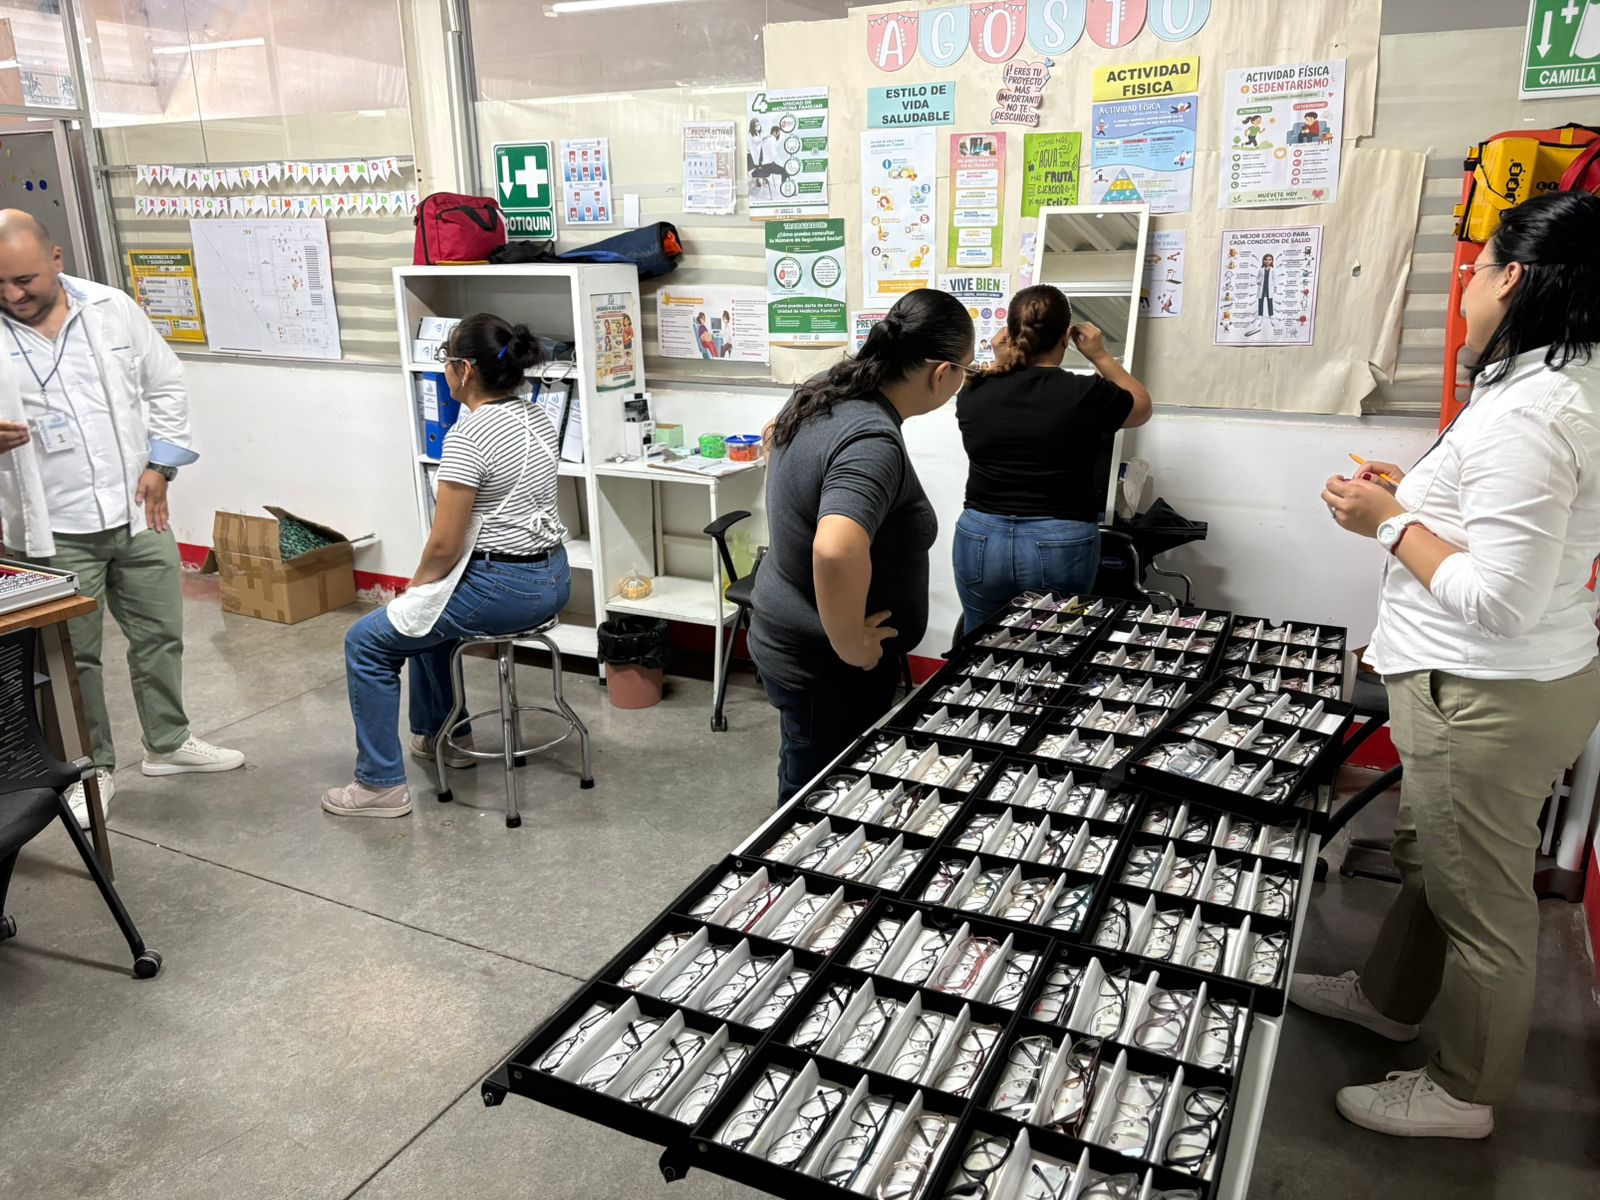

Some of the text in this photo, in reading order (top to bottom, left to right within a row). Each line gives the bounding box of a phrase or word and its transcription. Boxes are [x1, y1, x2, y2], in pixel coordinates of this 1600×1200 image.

[1014, 67, 1031, 76] ERES
[1033, 68, 1042, 76] TU
[1106, 62, 1190, 83] ACTIVIDAD
[1245, 65, 1329, 83] ACTIVIDAD FÍSICA
[1539, 67, 1596, 85] CAMILLA
[1007, 76, 1043, 86] PROYECTO
[1252, 77, 1329, 94] SEDENTARISMO
[886, 85, 947, 99] ESTILO DE
[1014, 85, 1031, 94] MÁS
[1122, 80, 1173, 97] FISICA
[902, 99, 929, 110] VIDA
[1006, 103, 1028, 113] NO TE
[1098, 104, 1137, 115] ACTIVIDAD
[882, 111, 950, 124] SALUDABLE
[1038, 139, 1054, 147] TOMA
[1039, 148, 1058, 168] AGUA
[288, 160, 393, 175] ENFERMOS
[1037, 184, 1064, 195] EJERCICIO
[138, 194, 417, 209] CRONICOS Y EMBARAZADAS
[949, 277, 1000, 291] VIVE BIEN
